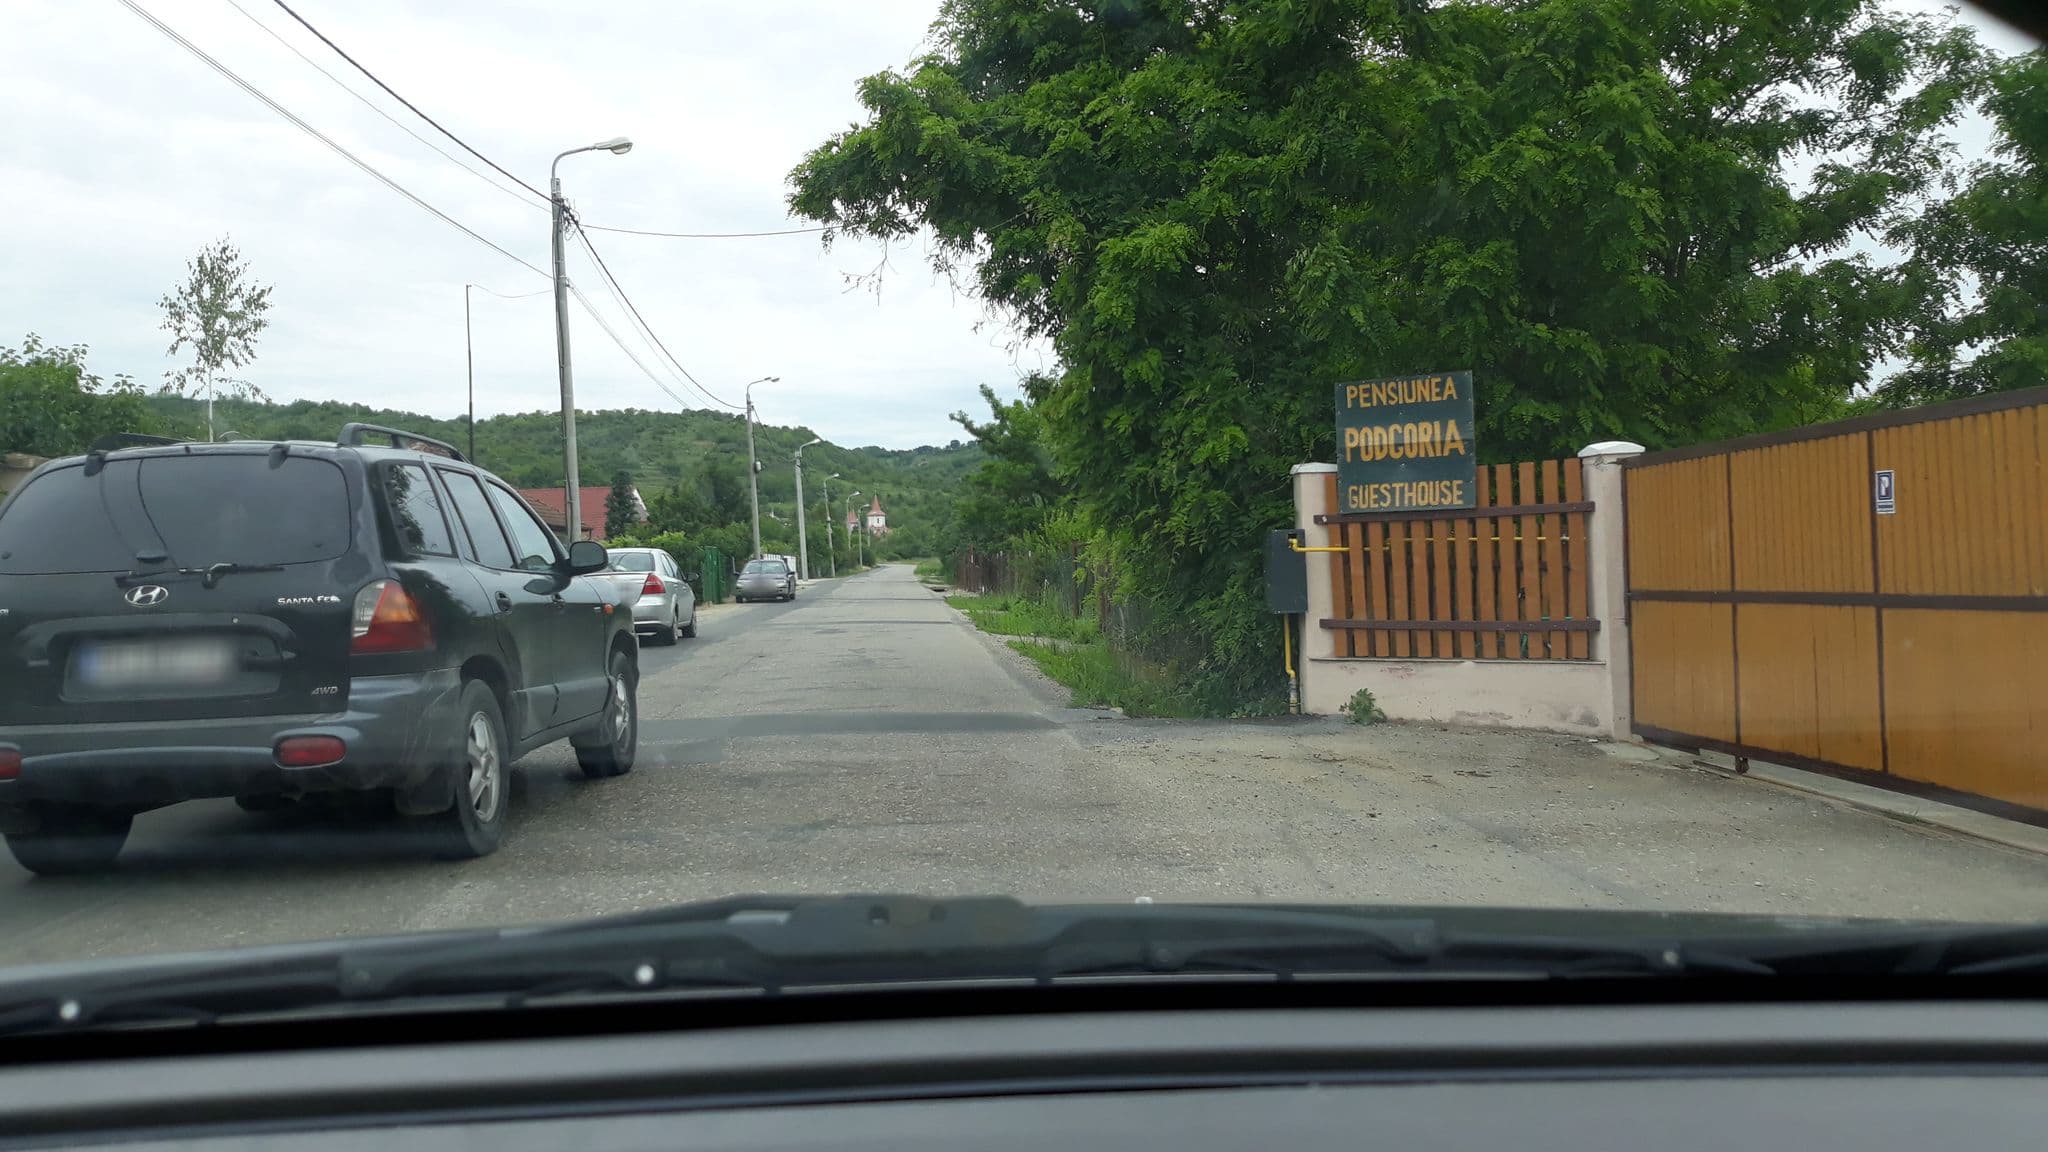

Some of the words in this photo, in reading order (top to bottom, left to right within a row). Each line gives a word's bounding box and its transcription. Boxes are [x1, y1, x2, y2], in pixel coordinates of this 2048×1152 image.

[1346, 376, 1458, 409] PENSIUNEA
[1344, 419, 1466, 463] PODCORIA
[1348, 479, 1464, 509] GUESTHOUSE
